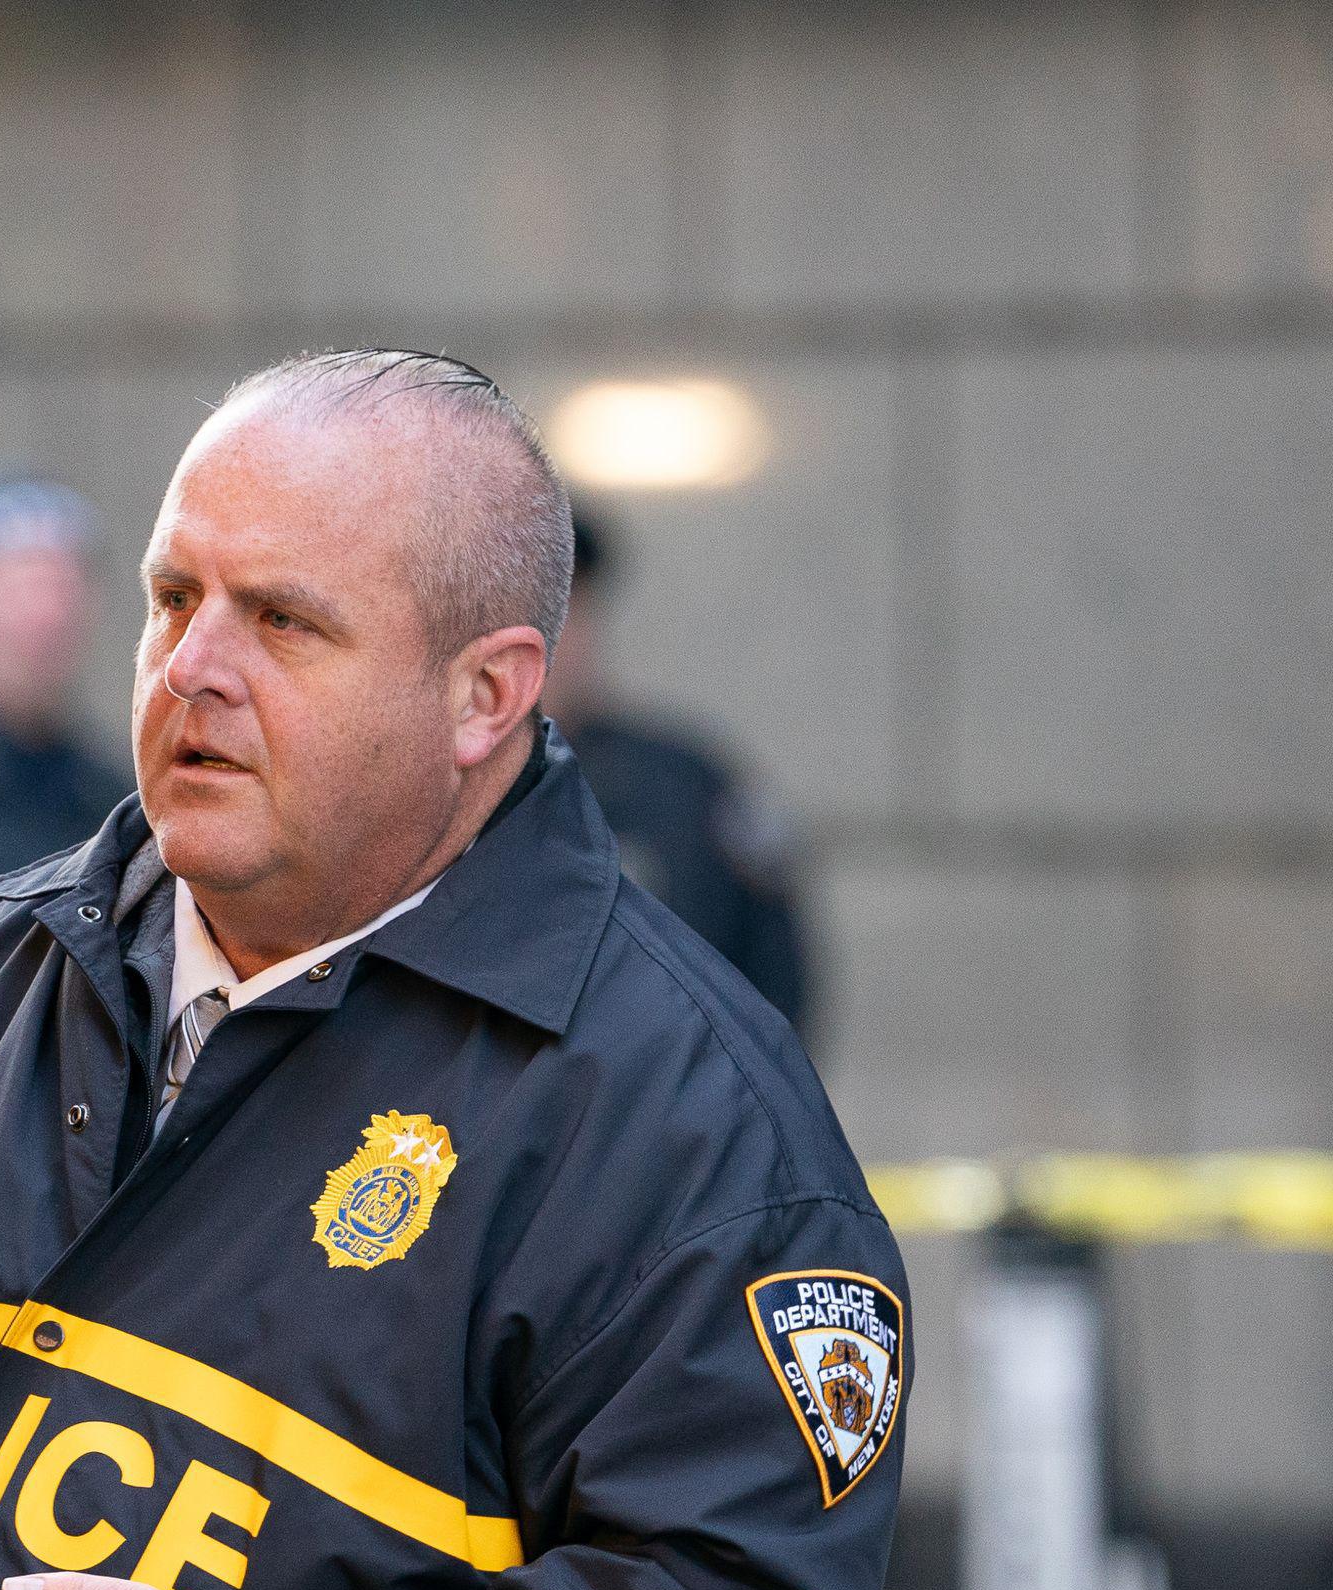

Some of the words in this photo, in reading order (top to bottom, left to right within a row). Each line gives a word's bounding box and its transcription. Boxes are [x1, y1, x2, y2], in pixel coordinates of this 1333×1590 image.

[329, 1226, 382, 1261] CHIEF
[797, 1281, 876, 1315] POLICE
[772, 1302, 897, 1354] DEPARTMENT
[784, 1361, 820, 1415] CITY
[815, 1424, 836, 1458] OF
[848, 1437, 876, 1481] NEW
[874, 1374, 899, 1436] YORK
